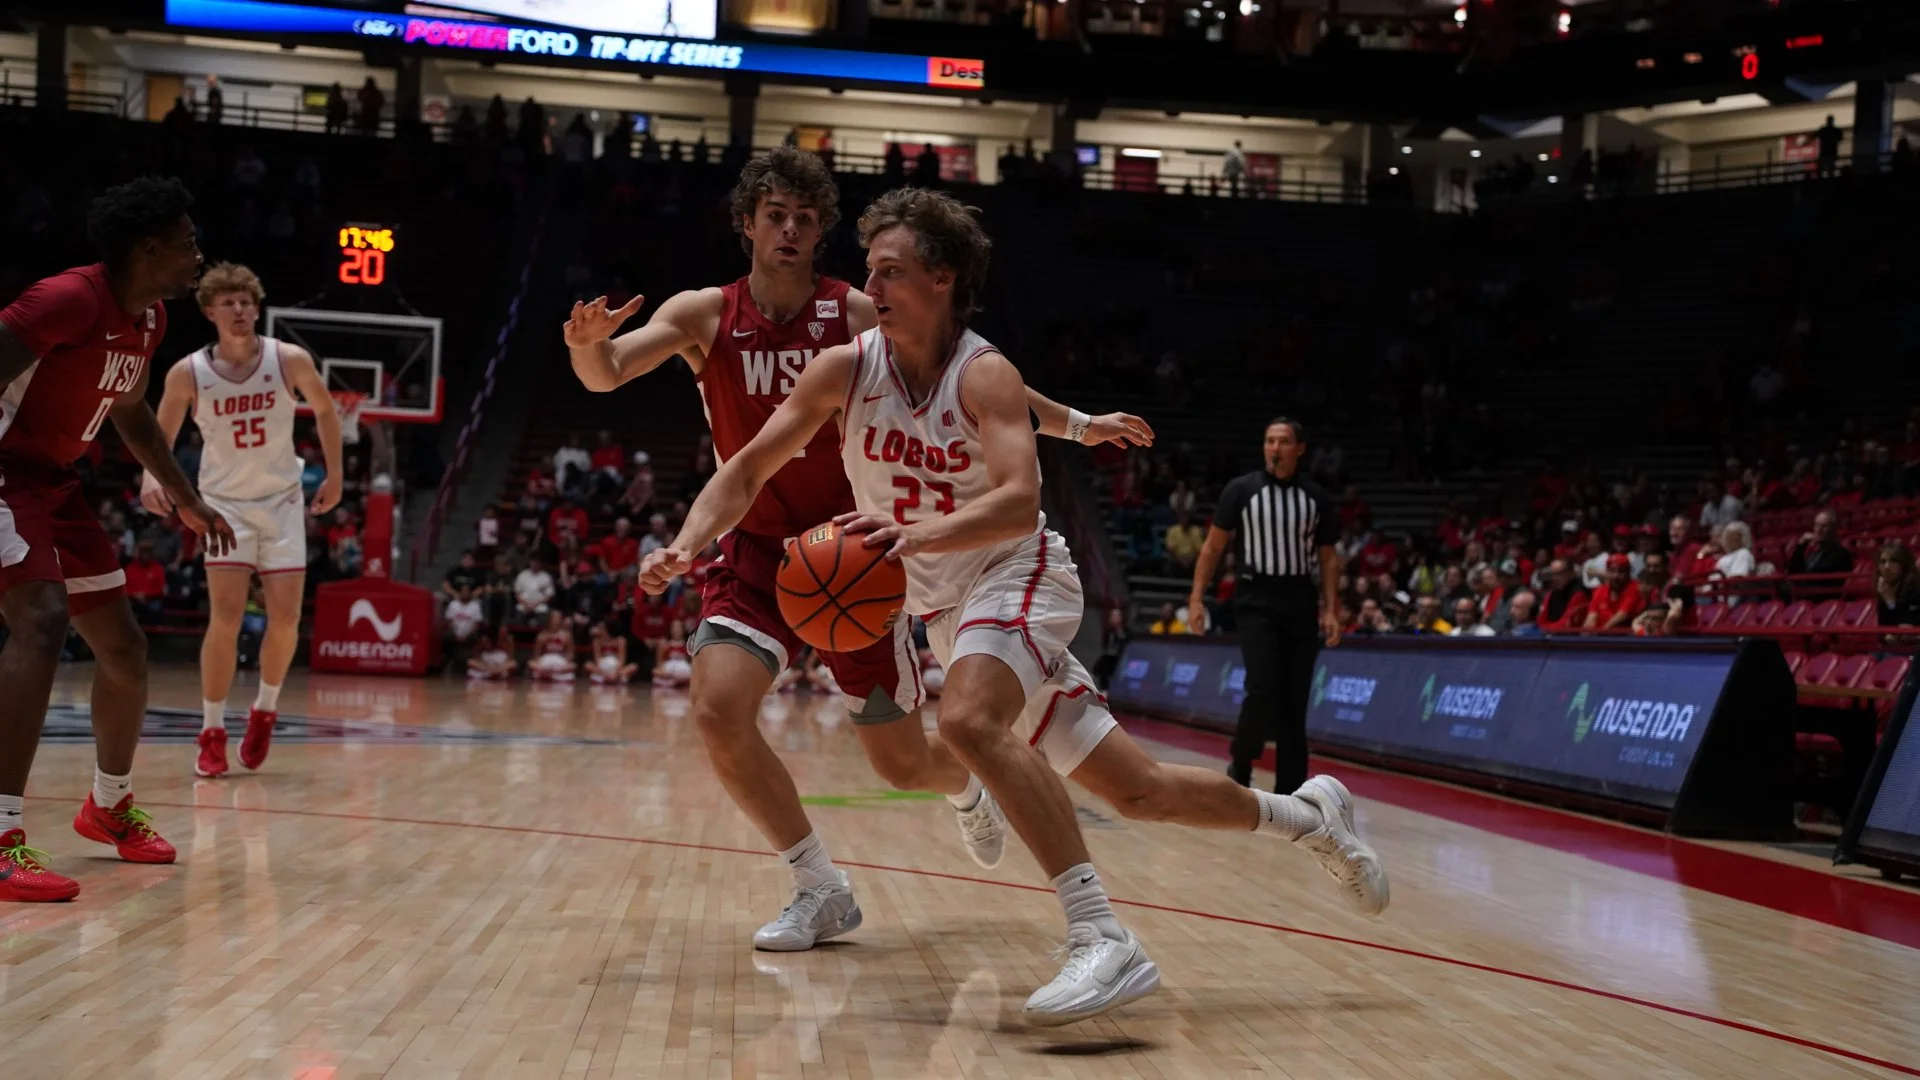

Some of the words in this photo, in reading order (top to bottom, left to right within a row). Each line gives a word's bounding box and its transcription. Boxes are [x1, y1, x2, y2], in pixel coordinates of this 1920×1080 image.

[668, 42, 743, 69] SERIES
[1742, 53, 1759, 80] 0
[340, 247, 385, 285] 20
[97, 351, 146, 393] WSU
[739, 348, 829, 396] WS
[80, 397, 115, 442] 0
[213, 390, 276, 417] LOBOS
[231, 416, 266, 449] 25
[863, 425, 971, 474] LOBOS
[318, 640, 414, 659] NUSENDA
[1593, 696, 1696, 743] NUSENDA
